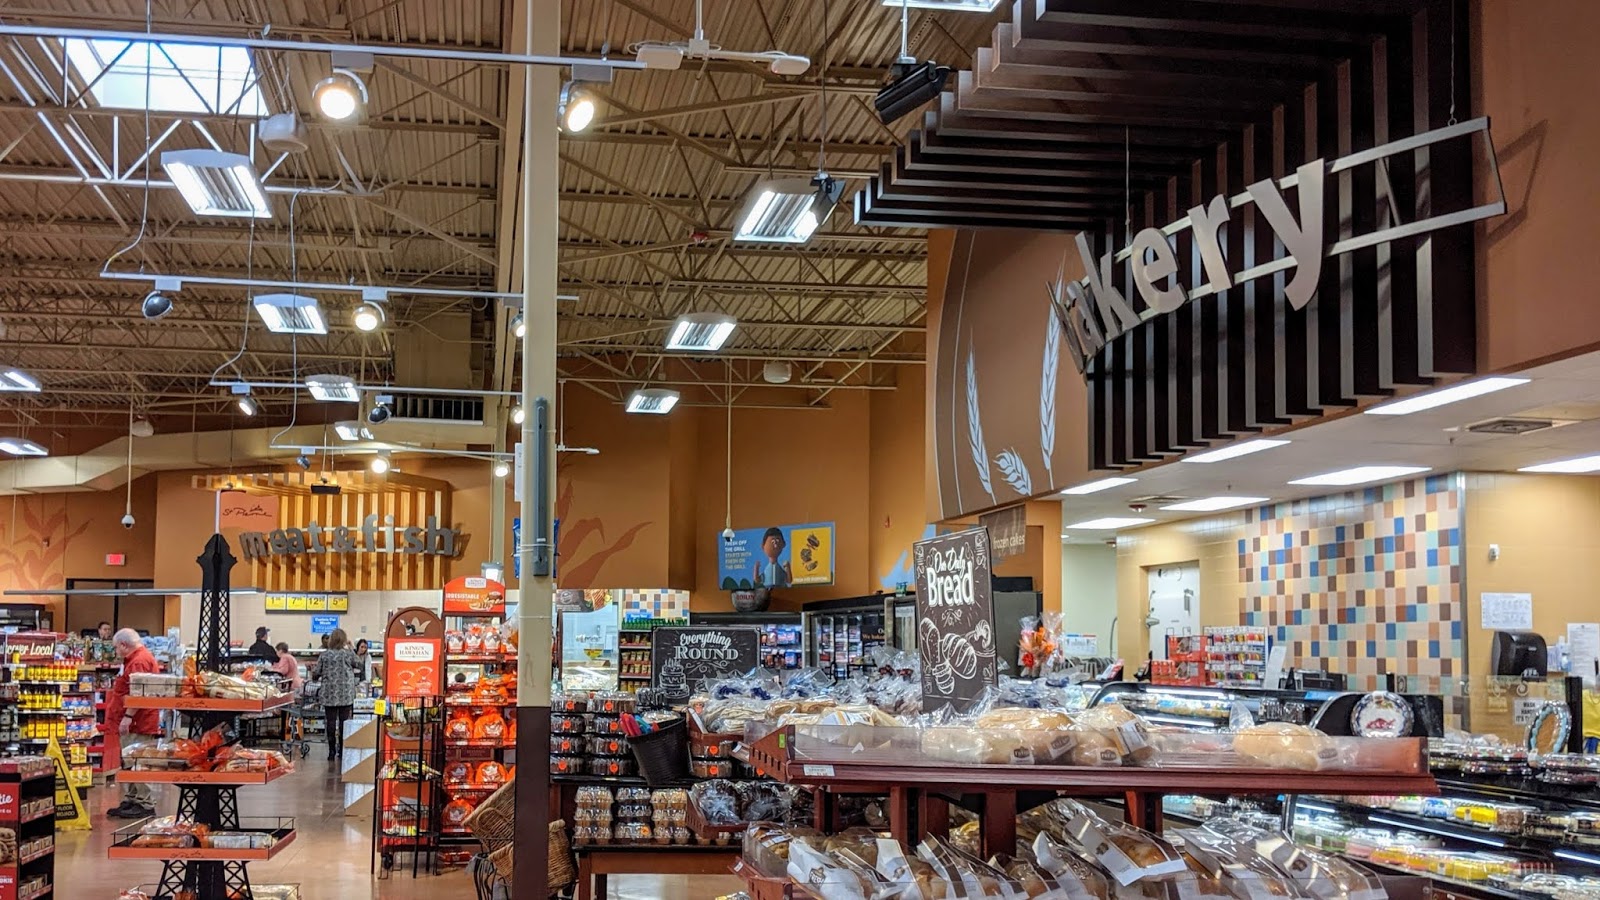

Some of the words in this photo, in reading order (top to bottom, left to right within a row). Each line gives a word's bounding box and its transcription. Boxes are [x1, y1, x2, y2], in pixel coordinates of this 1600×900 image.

[1045, 157, 1325, 374] akery
[993, 537, 1010, 550] frozen
[1010, 532, 1025, 547] cakes
[926, 560, 975, 607] Bread
[30, 642, 54, 656] Local
[679, 631, 733, 651] Everything
[673, 645, 739, 660] ROUND
